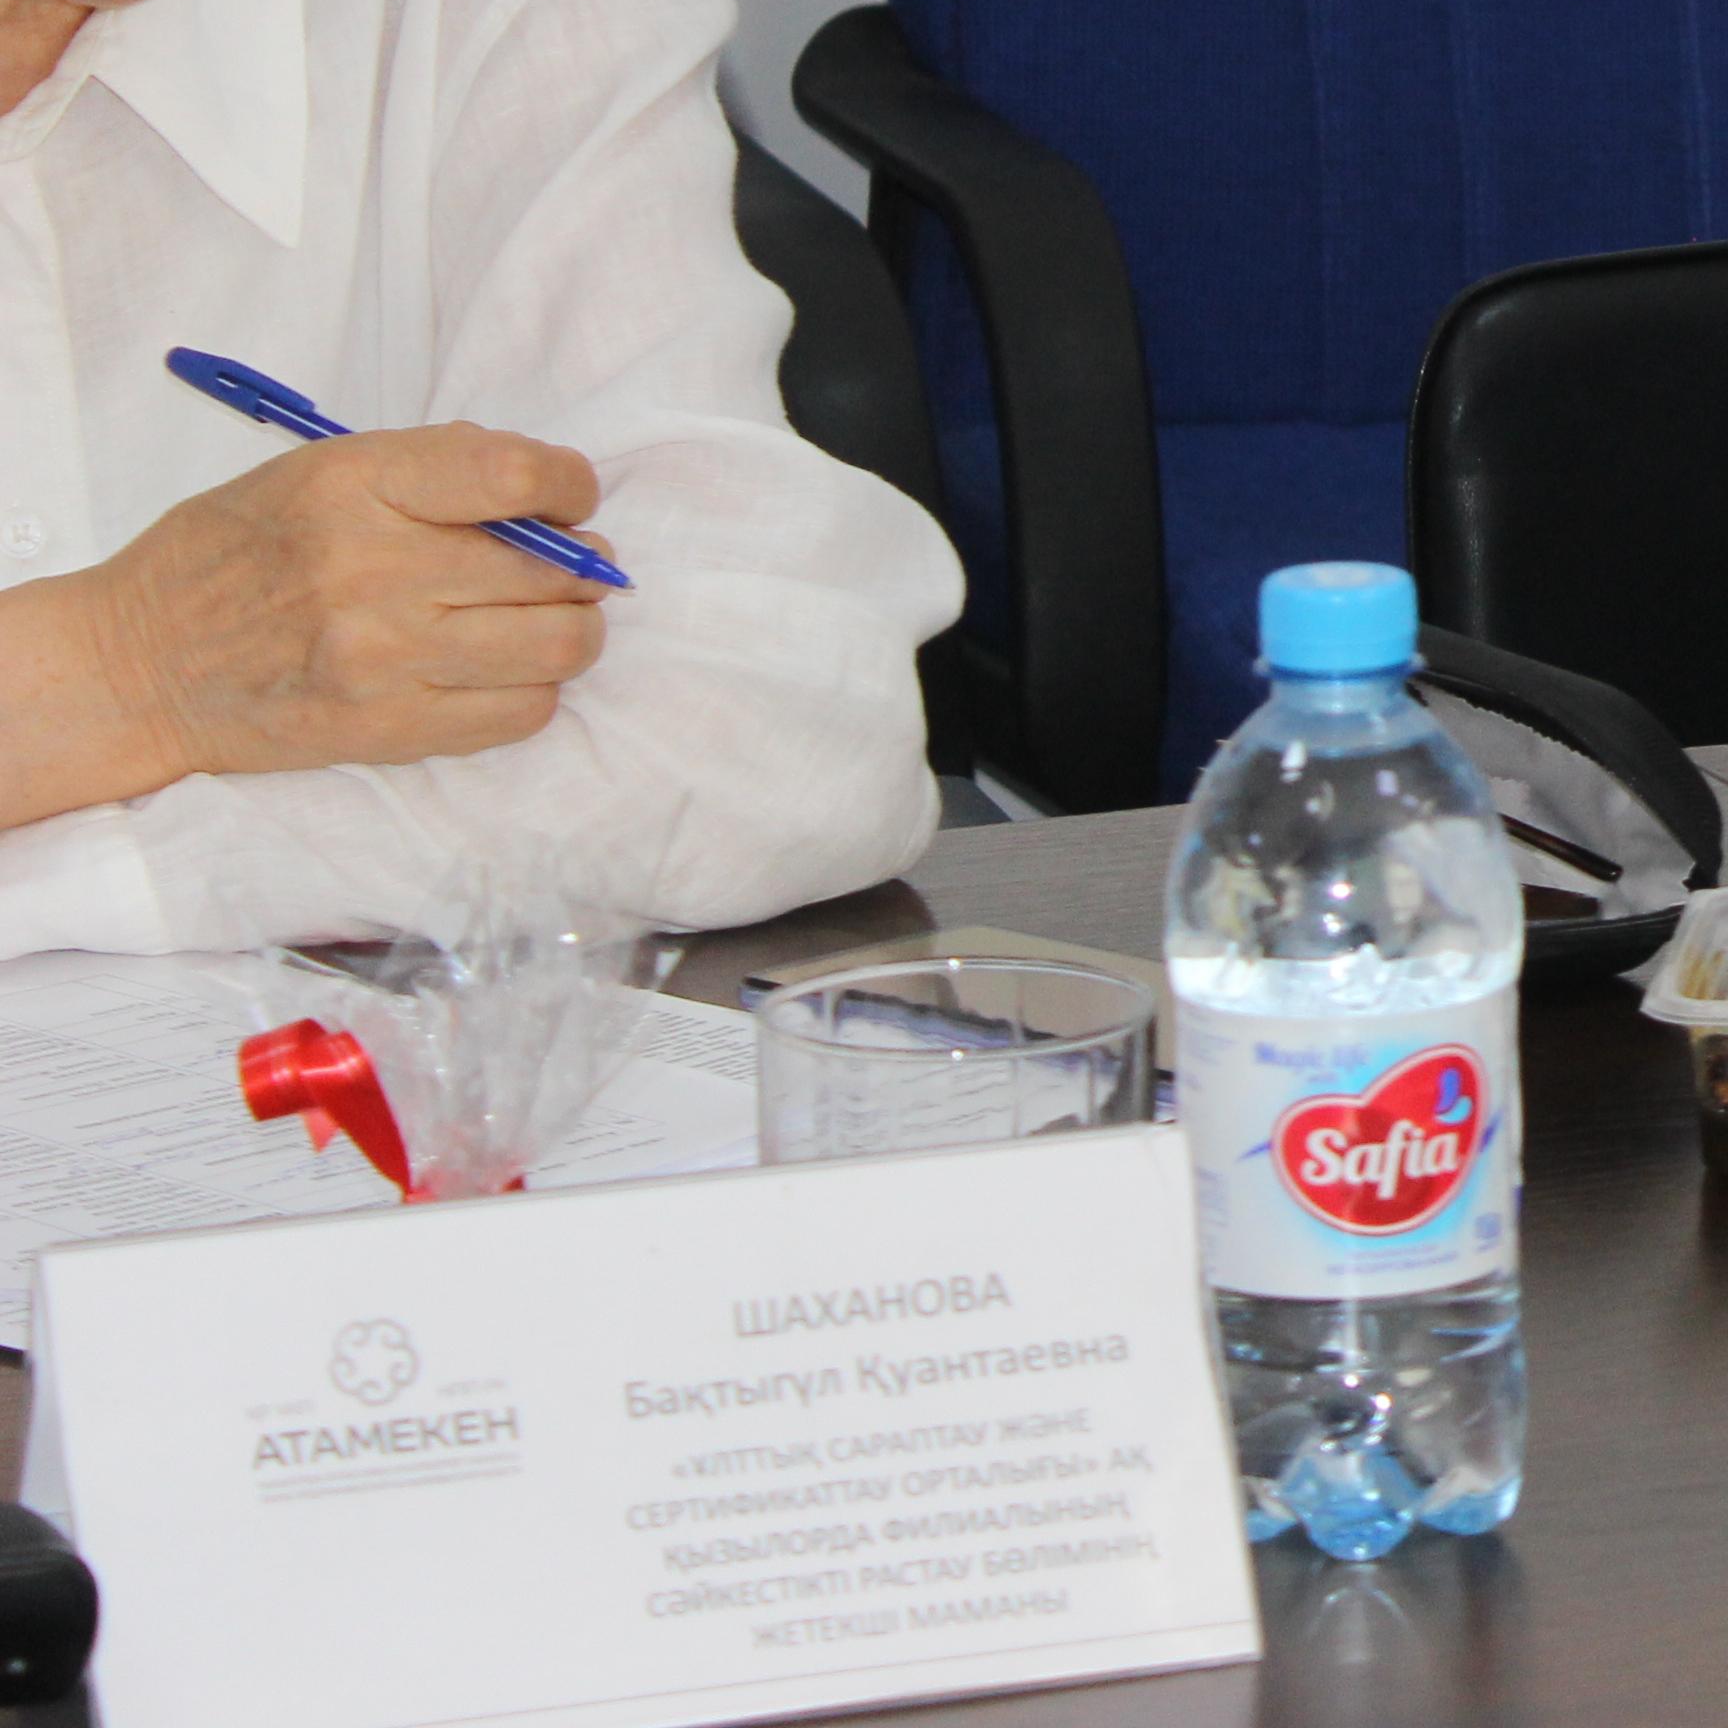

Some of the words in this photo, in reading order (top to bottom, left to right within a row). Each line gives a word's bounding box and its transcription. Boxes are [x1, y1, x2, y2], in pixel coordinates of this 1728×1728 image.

[1302, 1119, 1461, 1200] Safia
[733, 1271, 1013, 1340] ШАХАНОВА
[624, 1368, 843, 1420] Бақтыгүл
[856, 1331, 1131, 1398] Қуантаевна
[252, 1405, 521, 1470] АТАМЕКЕН
[827, 1422, 988, 1463] САРАПТАУ
[998, 1407, 1092, 1442] ЖӘНЕ
[625, 1475, 891, 1532] СЕРТИФИКАТТАУ
[1107, 1444, 1155, 1474] АҚ
[663, 1522, 875, 1574] ҚЫЗЫЛОРДА
[881, 1491, 1132, 1543] ФИЛИАЛЫНЫҢ
[859, 1553, 973, 1597] РАСТАУ
[906, 1588, 1070, 1630] МАМАНЫ
